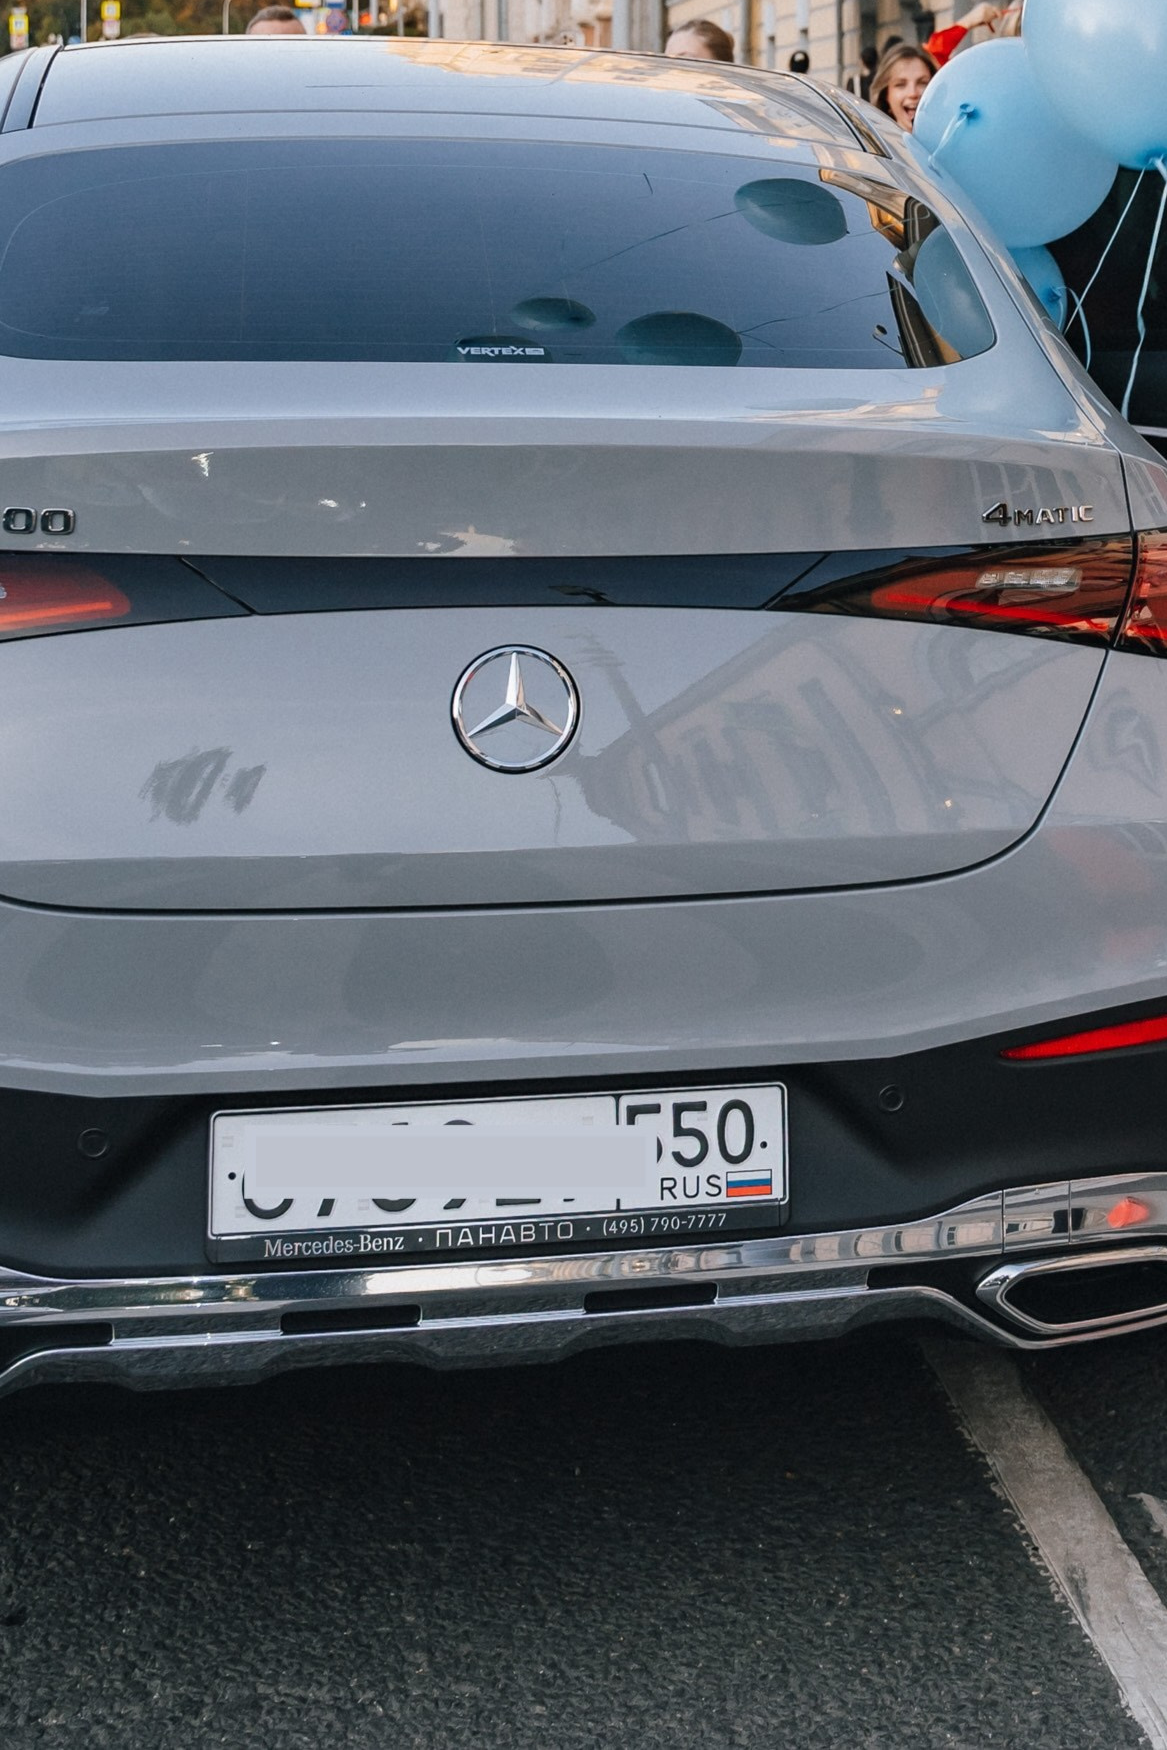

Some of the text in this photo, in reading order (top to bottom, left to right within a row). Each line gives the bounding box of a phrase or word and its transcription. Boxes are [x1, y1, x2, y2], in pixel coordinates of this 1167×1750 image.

[456, 345, 525, 357] VERTEX
[981, 502, 1095, 527] 4MATIC
[660, 1174, 723, 1201] RUS
[263, 1213, 727, 1258] Mercedes-Benz ПАНАВТО (495) 790-7777
